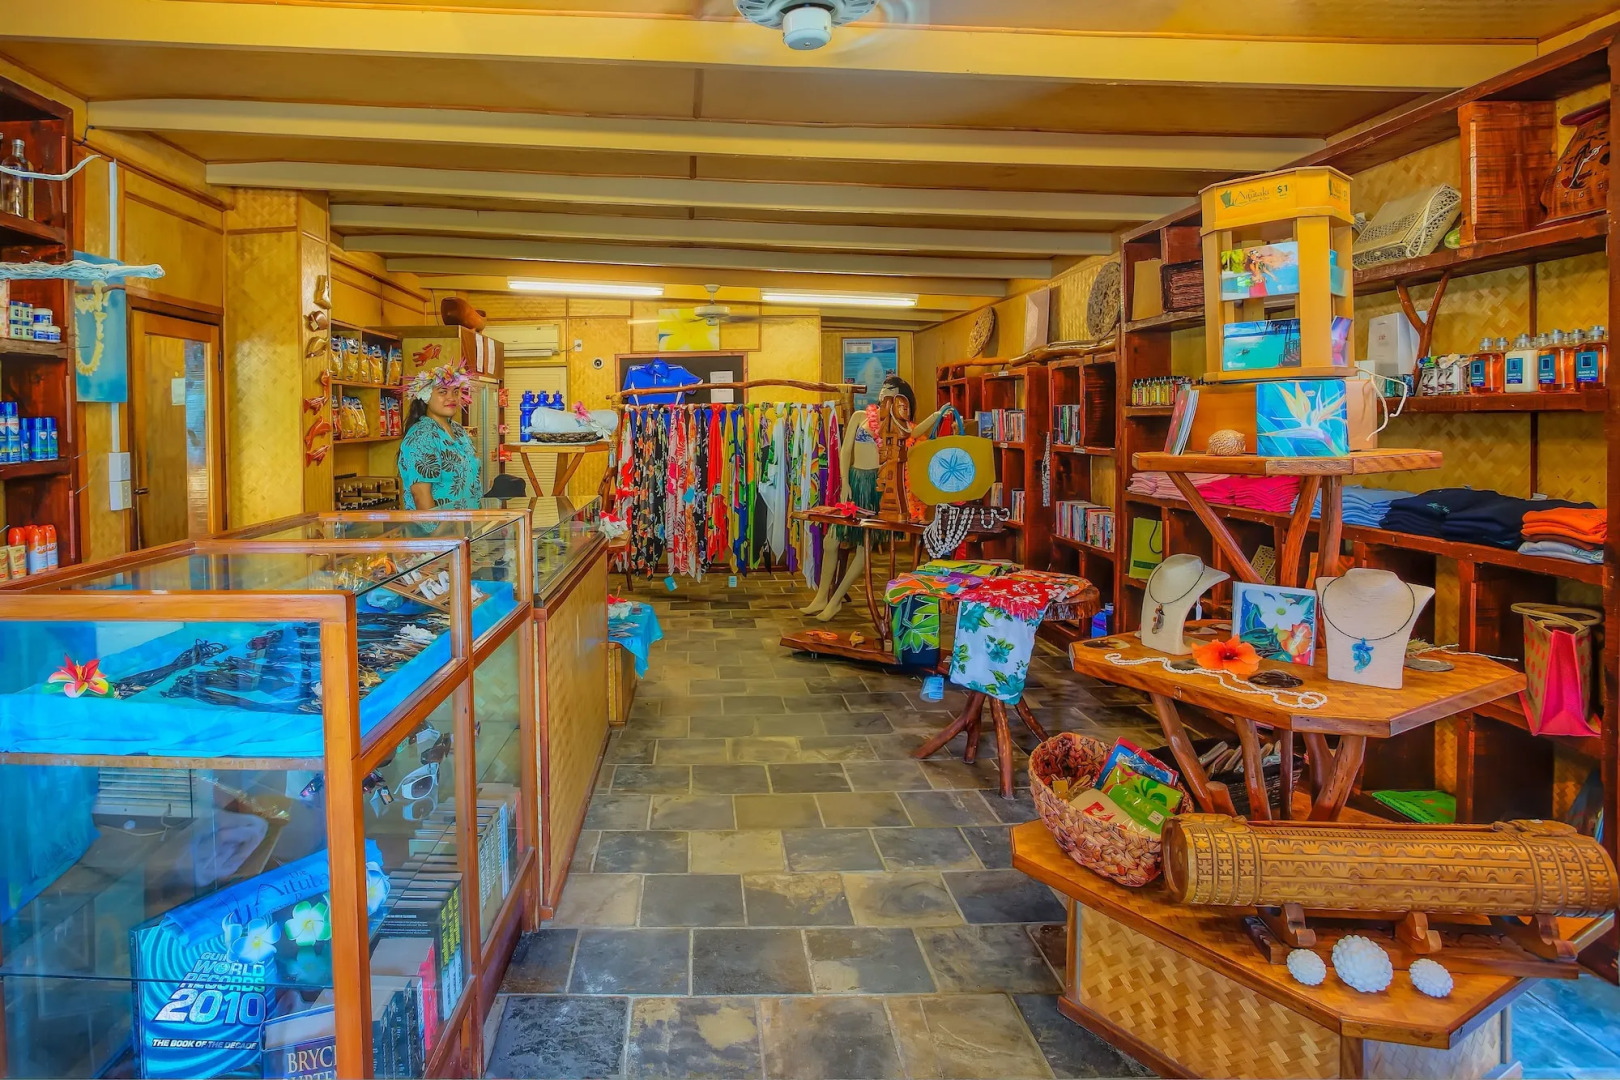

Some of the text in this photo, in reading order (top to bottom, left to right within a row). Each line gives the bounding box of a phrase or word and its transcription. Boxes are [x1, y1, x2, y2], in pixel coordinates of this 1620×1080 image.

[193, 959, 266, 978] WORLD
[178, 972, 266, 992] RECORDS
[154, 987, 267, 1026] 2010
[152, 1039, 257, 1050] THE BOOK OF THE DECADE
